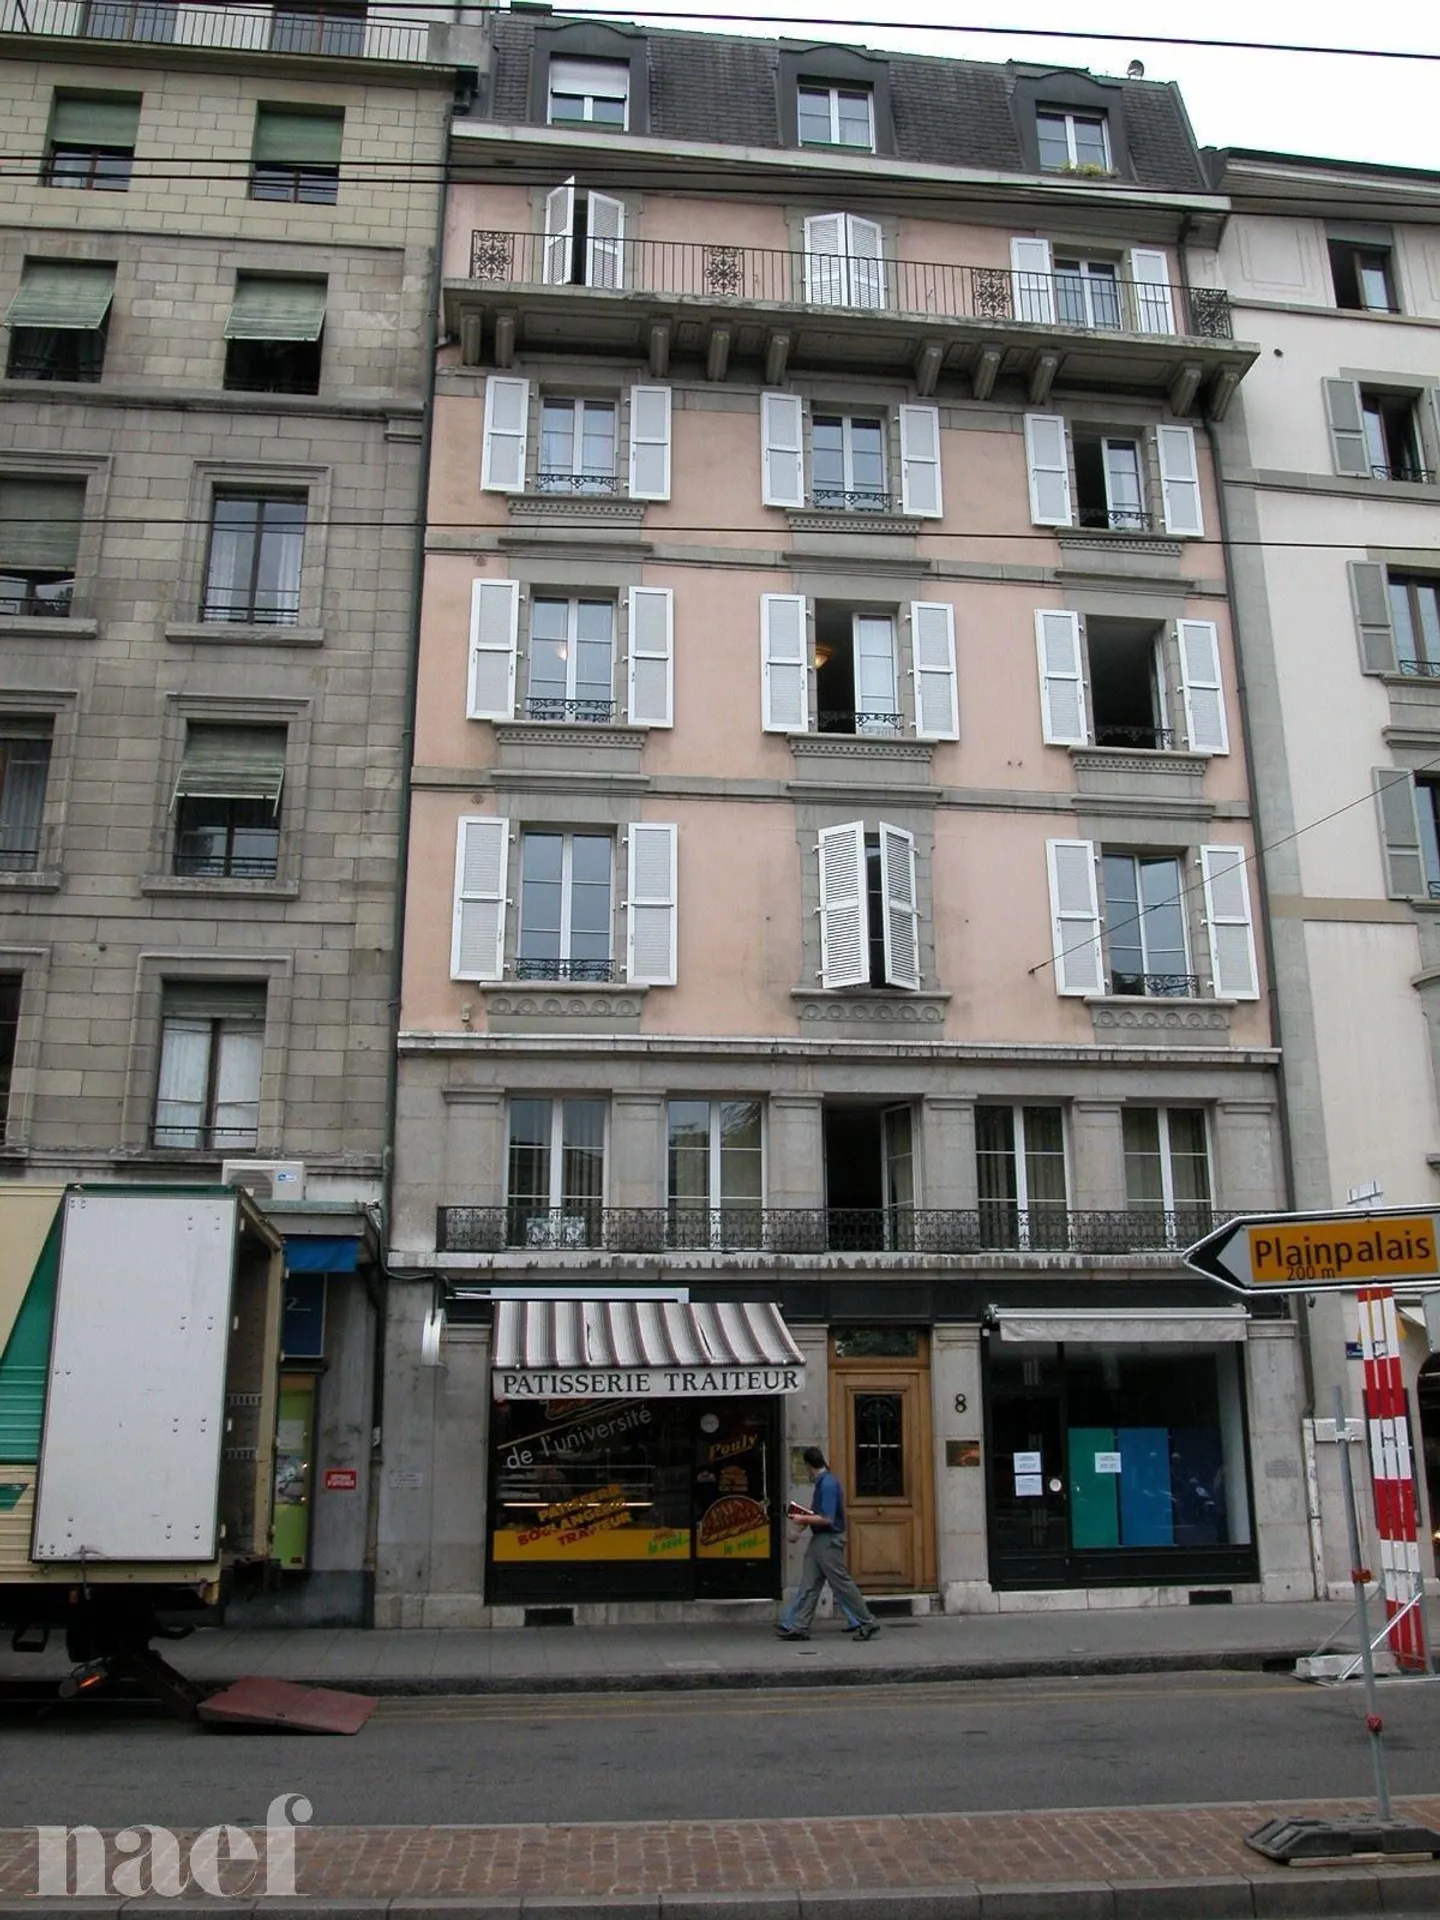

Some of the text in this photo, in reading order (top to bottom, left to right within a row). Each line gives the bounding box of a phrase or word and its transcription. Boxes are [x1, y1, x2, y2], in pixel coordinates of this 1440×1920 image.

[1255, 1230, 1431, 1271] Plainpalais
[1287, 1265, 1336, 1281] 200 m
[503, 1370, 800, 1394] PATISSERIE TRAITEUR
[955, 1393, 967, 1413] 8
[507, 1447, 534, 1469] de
[541, 1404, 652, 1457] l'université
